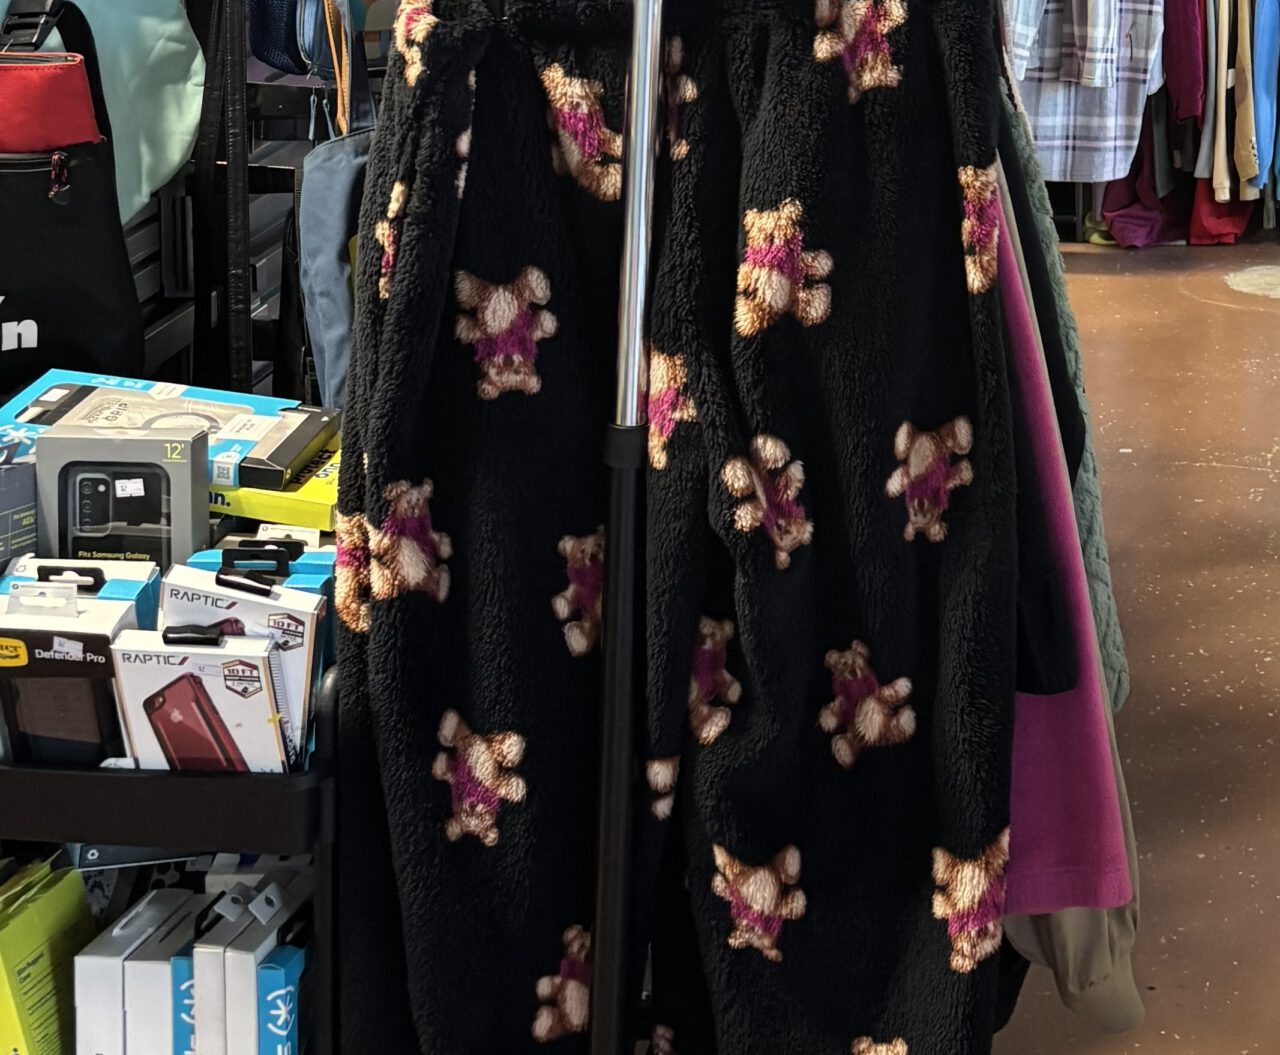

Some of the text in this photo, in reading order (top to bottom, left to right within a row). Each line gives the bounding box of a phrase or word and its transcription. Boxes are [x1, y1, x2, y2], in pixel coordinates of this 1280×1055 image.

[164, 442, 185, 459] 12'
[78, 550, 151, 561] Fits Samsung Galaxy
[170, 588, 226, 609] RAPTIC
[86, 652, 106, 664] Pro
[122, 652, 178, 666] RAPTIC
[241, 669, 257, 677] FT
